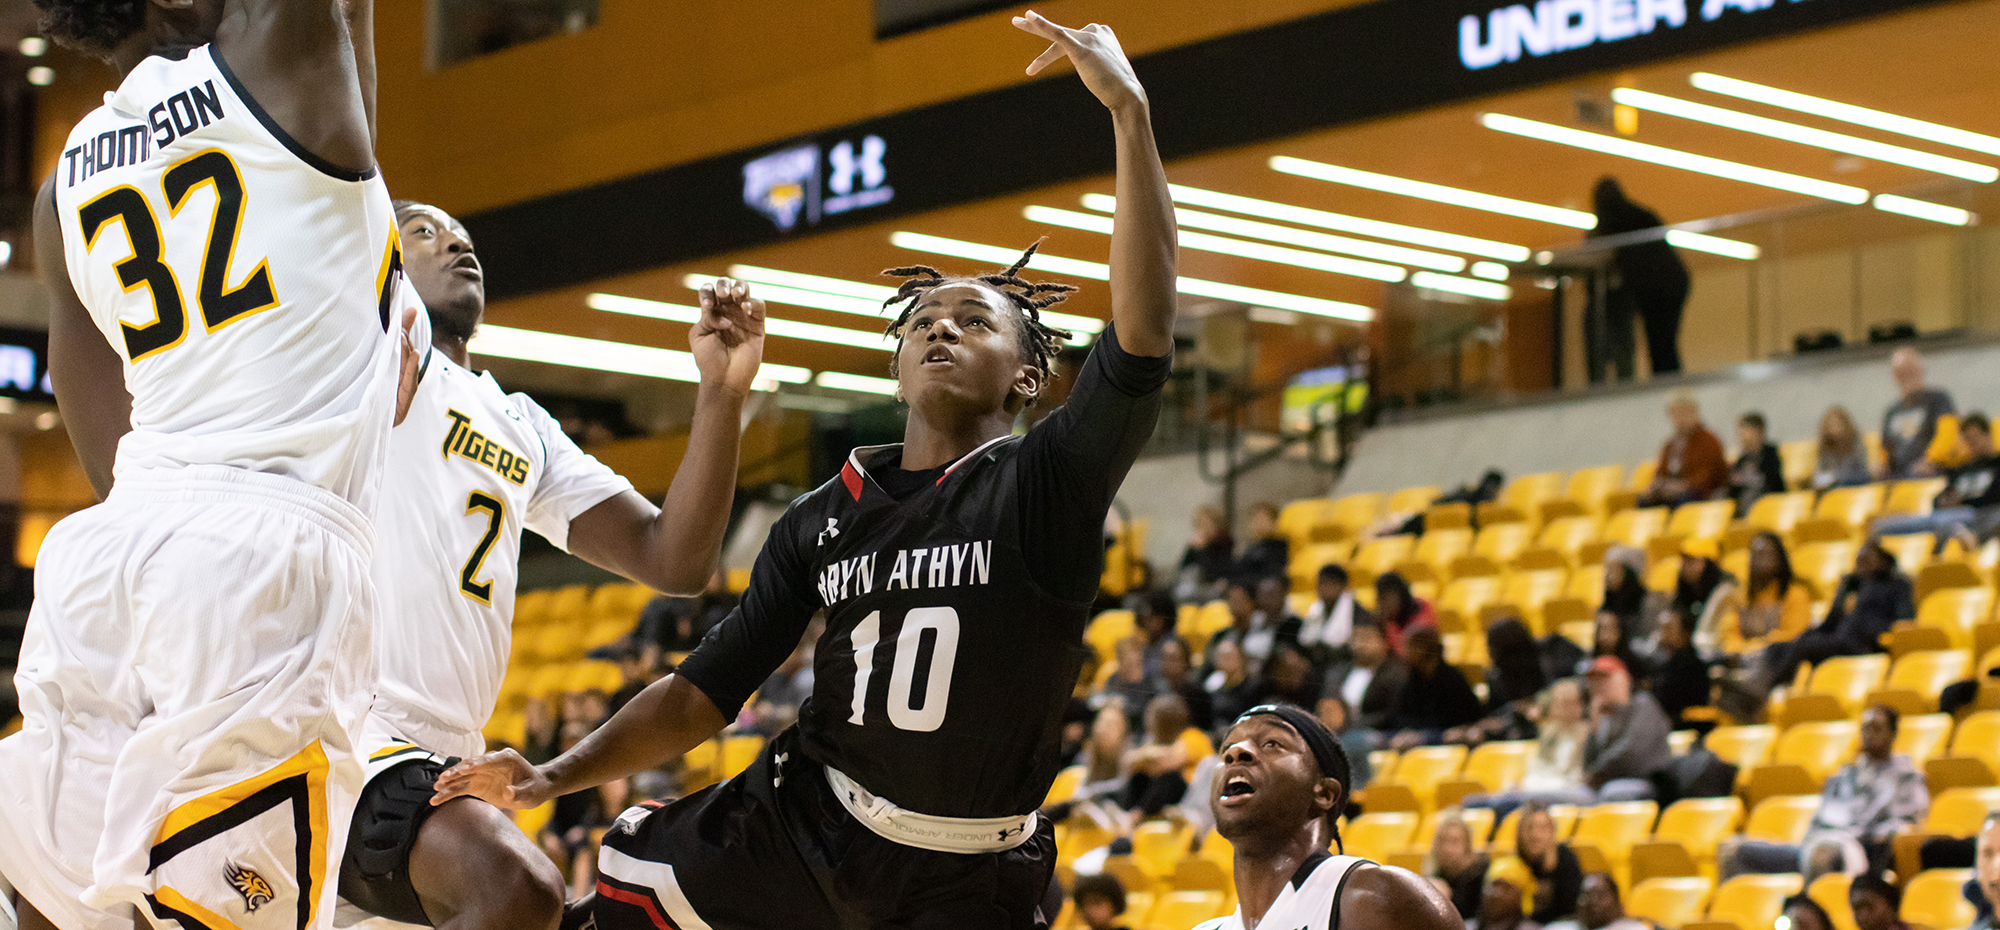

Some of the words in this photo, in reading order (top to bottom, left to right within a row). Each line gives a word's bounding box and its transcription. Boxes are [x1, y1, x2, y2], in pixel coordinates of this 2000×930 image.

[65, 79, 224, 188] THOMSON
[77, 147, 280, 365] 32
[441, 407, 530, 487] TIGERS
[459, 489, 506, 608] 2
[886, 540, 992, 591] ATHYN
[847, 606, 960, 732] 10
